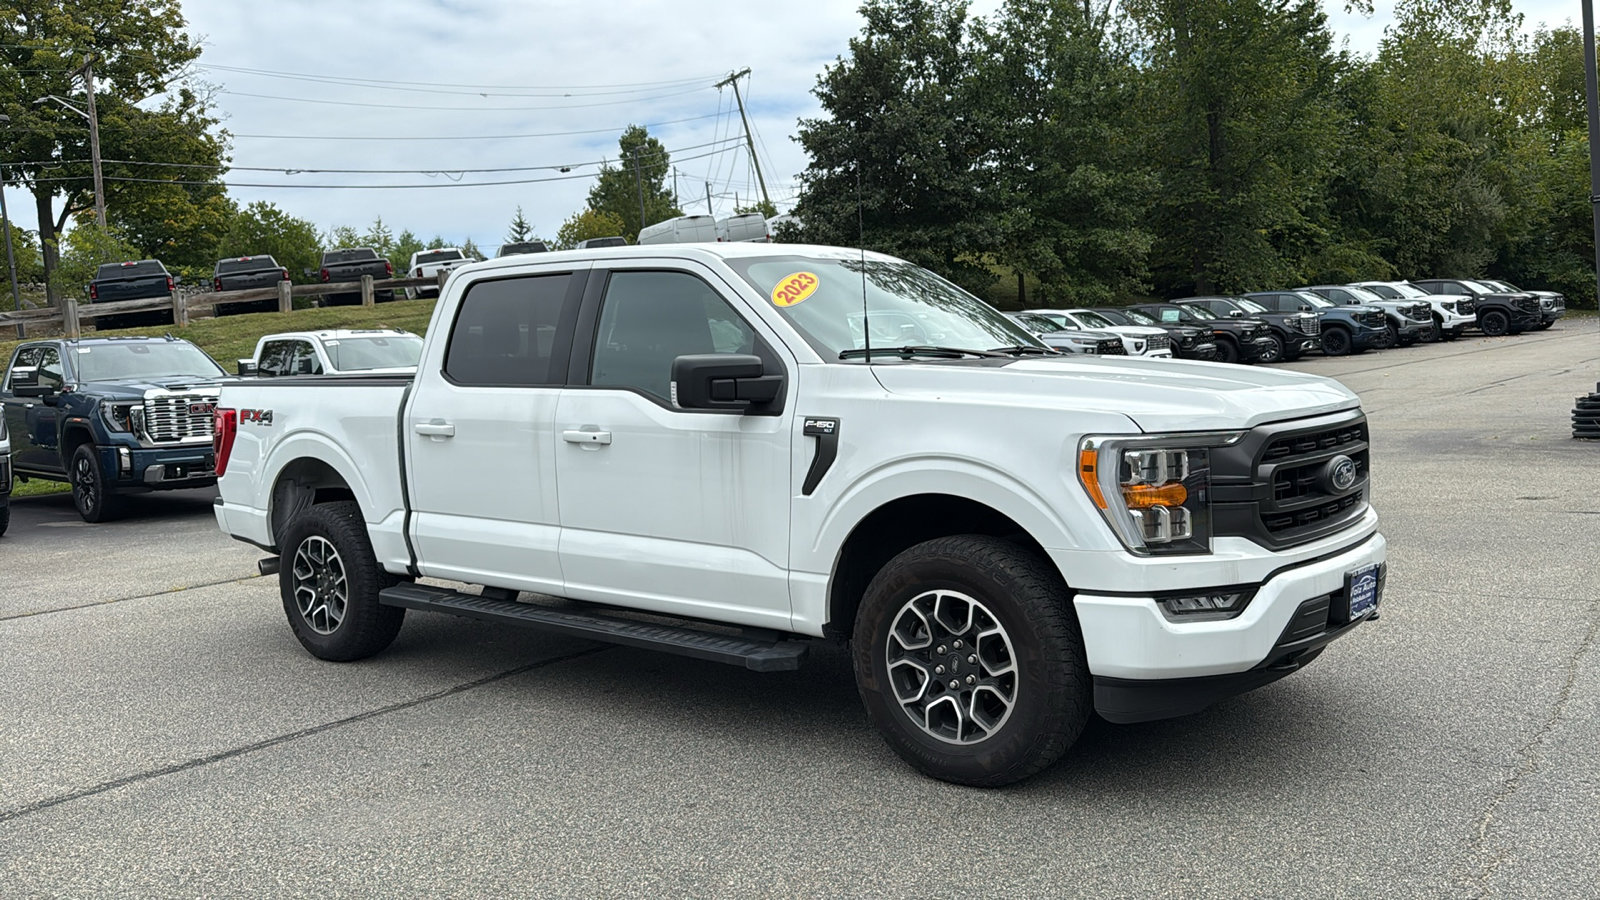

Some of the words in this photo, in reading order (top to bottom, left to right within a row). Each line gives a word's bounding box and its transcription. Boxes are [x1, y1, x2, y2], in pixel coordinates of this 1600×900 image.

[777, 273, 816, 304] 2023
[191, 403, 214, 413] GM
[240, 409, 273, 424] FX4
[805, 420, 835, 428] F-150
